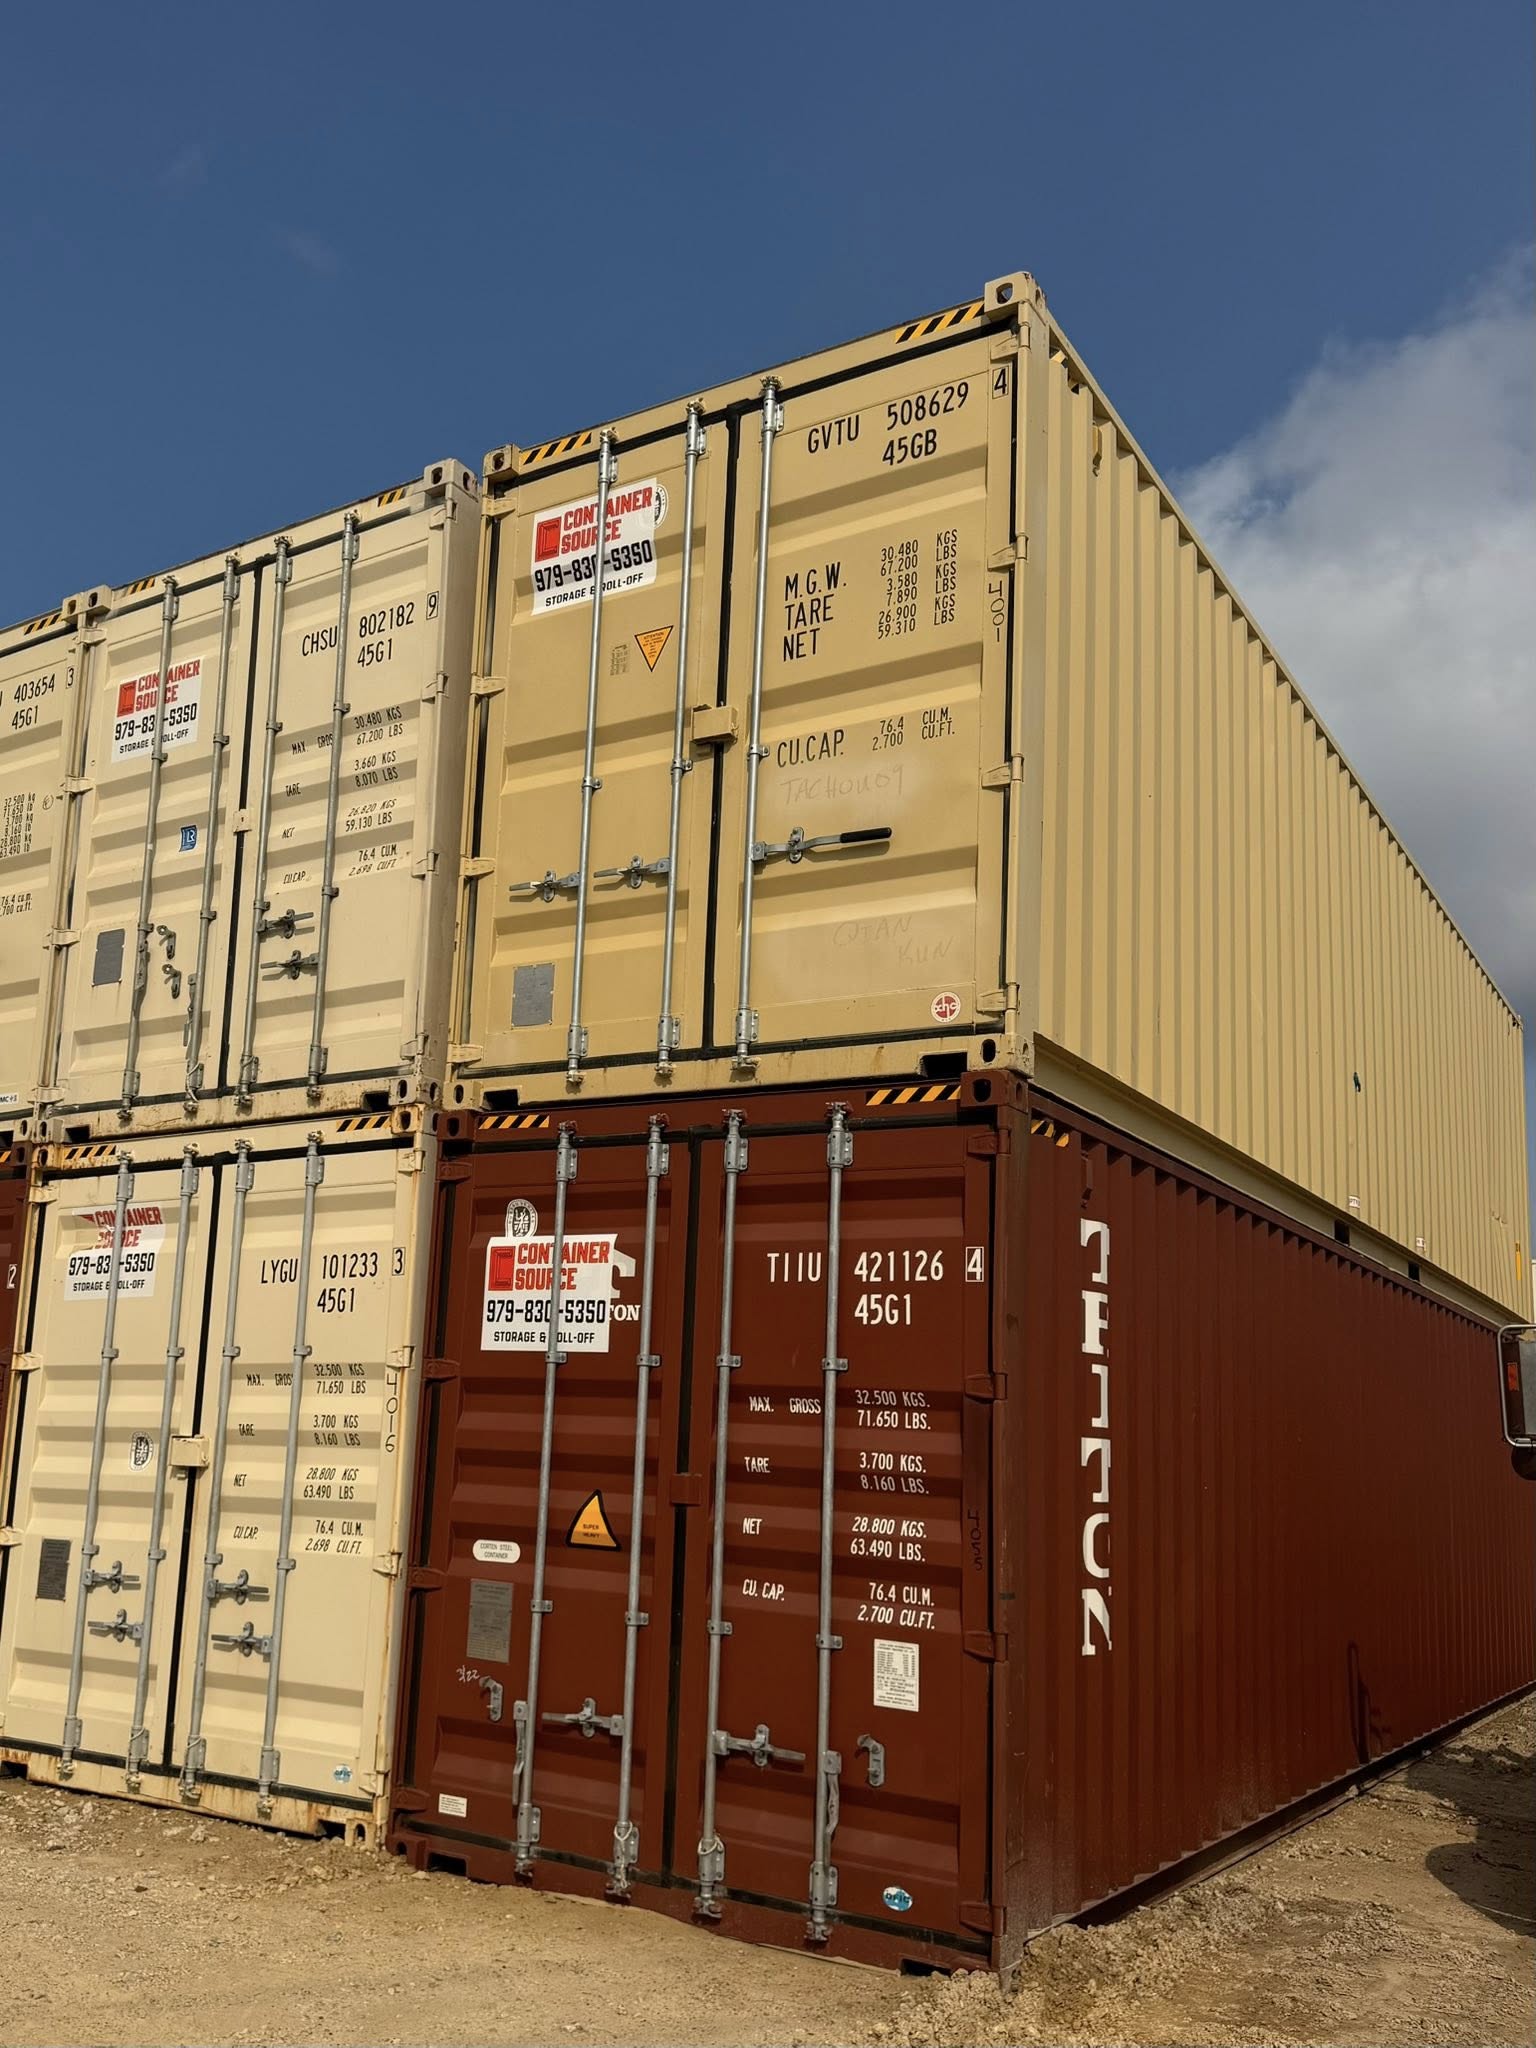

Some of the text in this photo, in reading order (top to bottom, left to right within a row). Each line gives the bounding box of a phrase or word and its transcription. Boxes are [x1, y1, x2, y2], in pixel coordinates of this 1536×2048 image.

[808, 368, 1008, 454] GVTU 508629 4
[882, 428, 937, 466] 45GB
[785, 529, 958, 602] M.G.W. 30.480 KGS
[880, 544, 957, 577] 67.200 LBS
[545, 588, 586, 607] STORAGE
[785, 561, 957, 631] TARE 3.580 KGS
[886, 576, 956, 607] 7.890 LBS
[302, 594, 437, 657] CHSU 802182 9
[783, 593, 956, 662] NET 26.900 KGS
[877, 608, 955, 640] 59.310 LBS
[357, 638, 393, 668] 45G1
[14, 673, 55, 703] 403654
[67, 667, 75, 687] 3
[138, 659, 200, 692] CONAINER
[136, 684, 179, 711] SOUCE
[12, 705, 38, 730] 45G1
[115, 702, 198, 741] 979-83-5350
[354, 715, 382, 730] 30.480
[388, 706, 403, 721] KGS
[120, 728, 189, 754] STORAGE OLL-OFF
[356, 723, 403, 745] 67.200 LBS
[777, 729, 845, 768] CU.CAP.
[879, 716, 904, 735] 76.4
[872, 731, 904, 751] 2.700
[286, 751, 396, 797] TARE 3.660 KGS
[383, 767, 399, 782] LBS
[345, 812, 393, 832] 59.130 LBS
[359, 849, 376, 862] 76.4
[95, 1206, 163, 1227] CONAINER
[68, 1252, 155, 1276] 979-83-5350
[261, 1249, 403, 1284] LYGU 101233 3
[767, 1247, 982, 1283] TIIU 421126 4
[8, 1265, 17, 1288] 2
[73, 1279, 145, 1292] STORAGE OLL-OFF
[317, 1288, 355, 1313] 45G1
[854, 1293, 912, 1326] 45G1
[493, 1331, 595, 1344] STORAGE & OLL-OFF
[314, 1364, 342, 1377] 32.500
[348, 1363, 365, 1376] KGS
[316, 1381, 366, 1394] 71.650 LBS
[749, 1389, 931, 1414] MAX. GROSS 32.500 KGS.
[239, 1415, 359, 1436] TARE 3.700 KGS
[857, 1409, 931, 1430] 71.650 LBS.
[314, 1433, 361, 1446] 8.160 LBS
[744, 1452, 927, 1474] TARE 3.700 KGS.
[234, 1467, 359, 1487] NET 28.800 KGS
[860, 1474, 930, 1494] 8.160 LBS.
[304, 1485, 354, 1500] 63.490 LBS
[316, 1520, 334, 1534] 76.4
[742, 1516, 927, 1539] NET 28.800 KGS.
[305, 1538, 330, 1552] 2.698
[850, 1538, 926, 1562] 63.490 LBS.
[869, 1582, 896, 1602] 76.4
[902, 1585, 935, 1607] CU.M.
[857, 1604, 936, 1630] 2.700 CU.FT.
